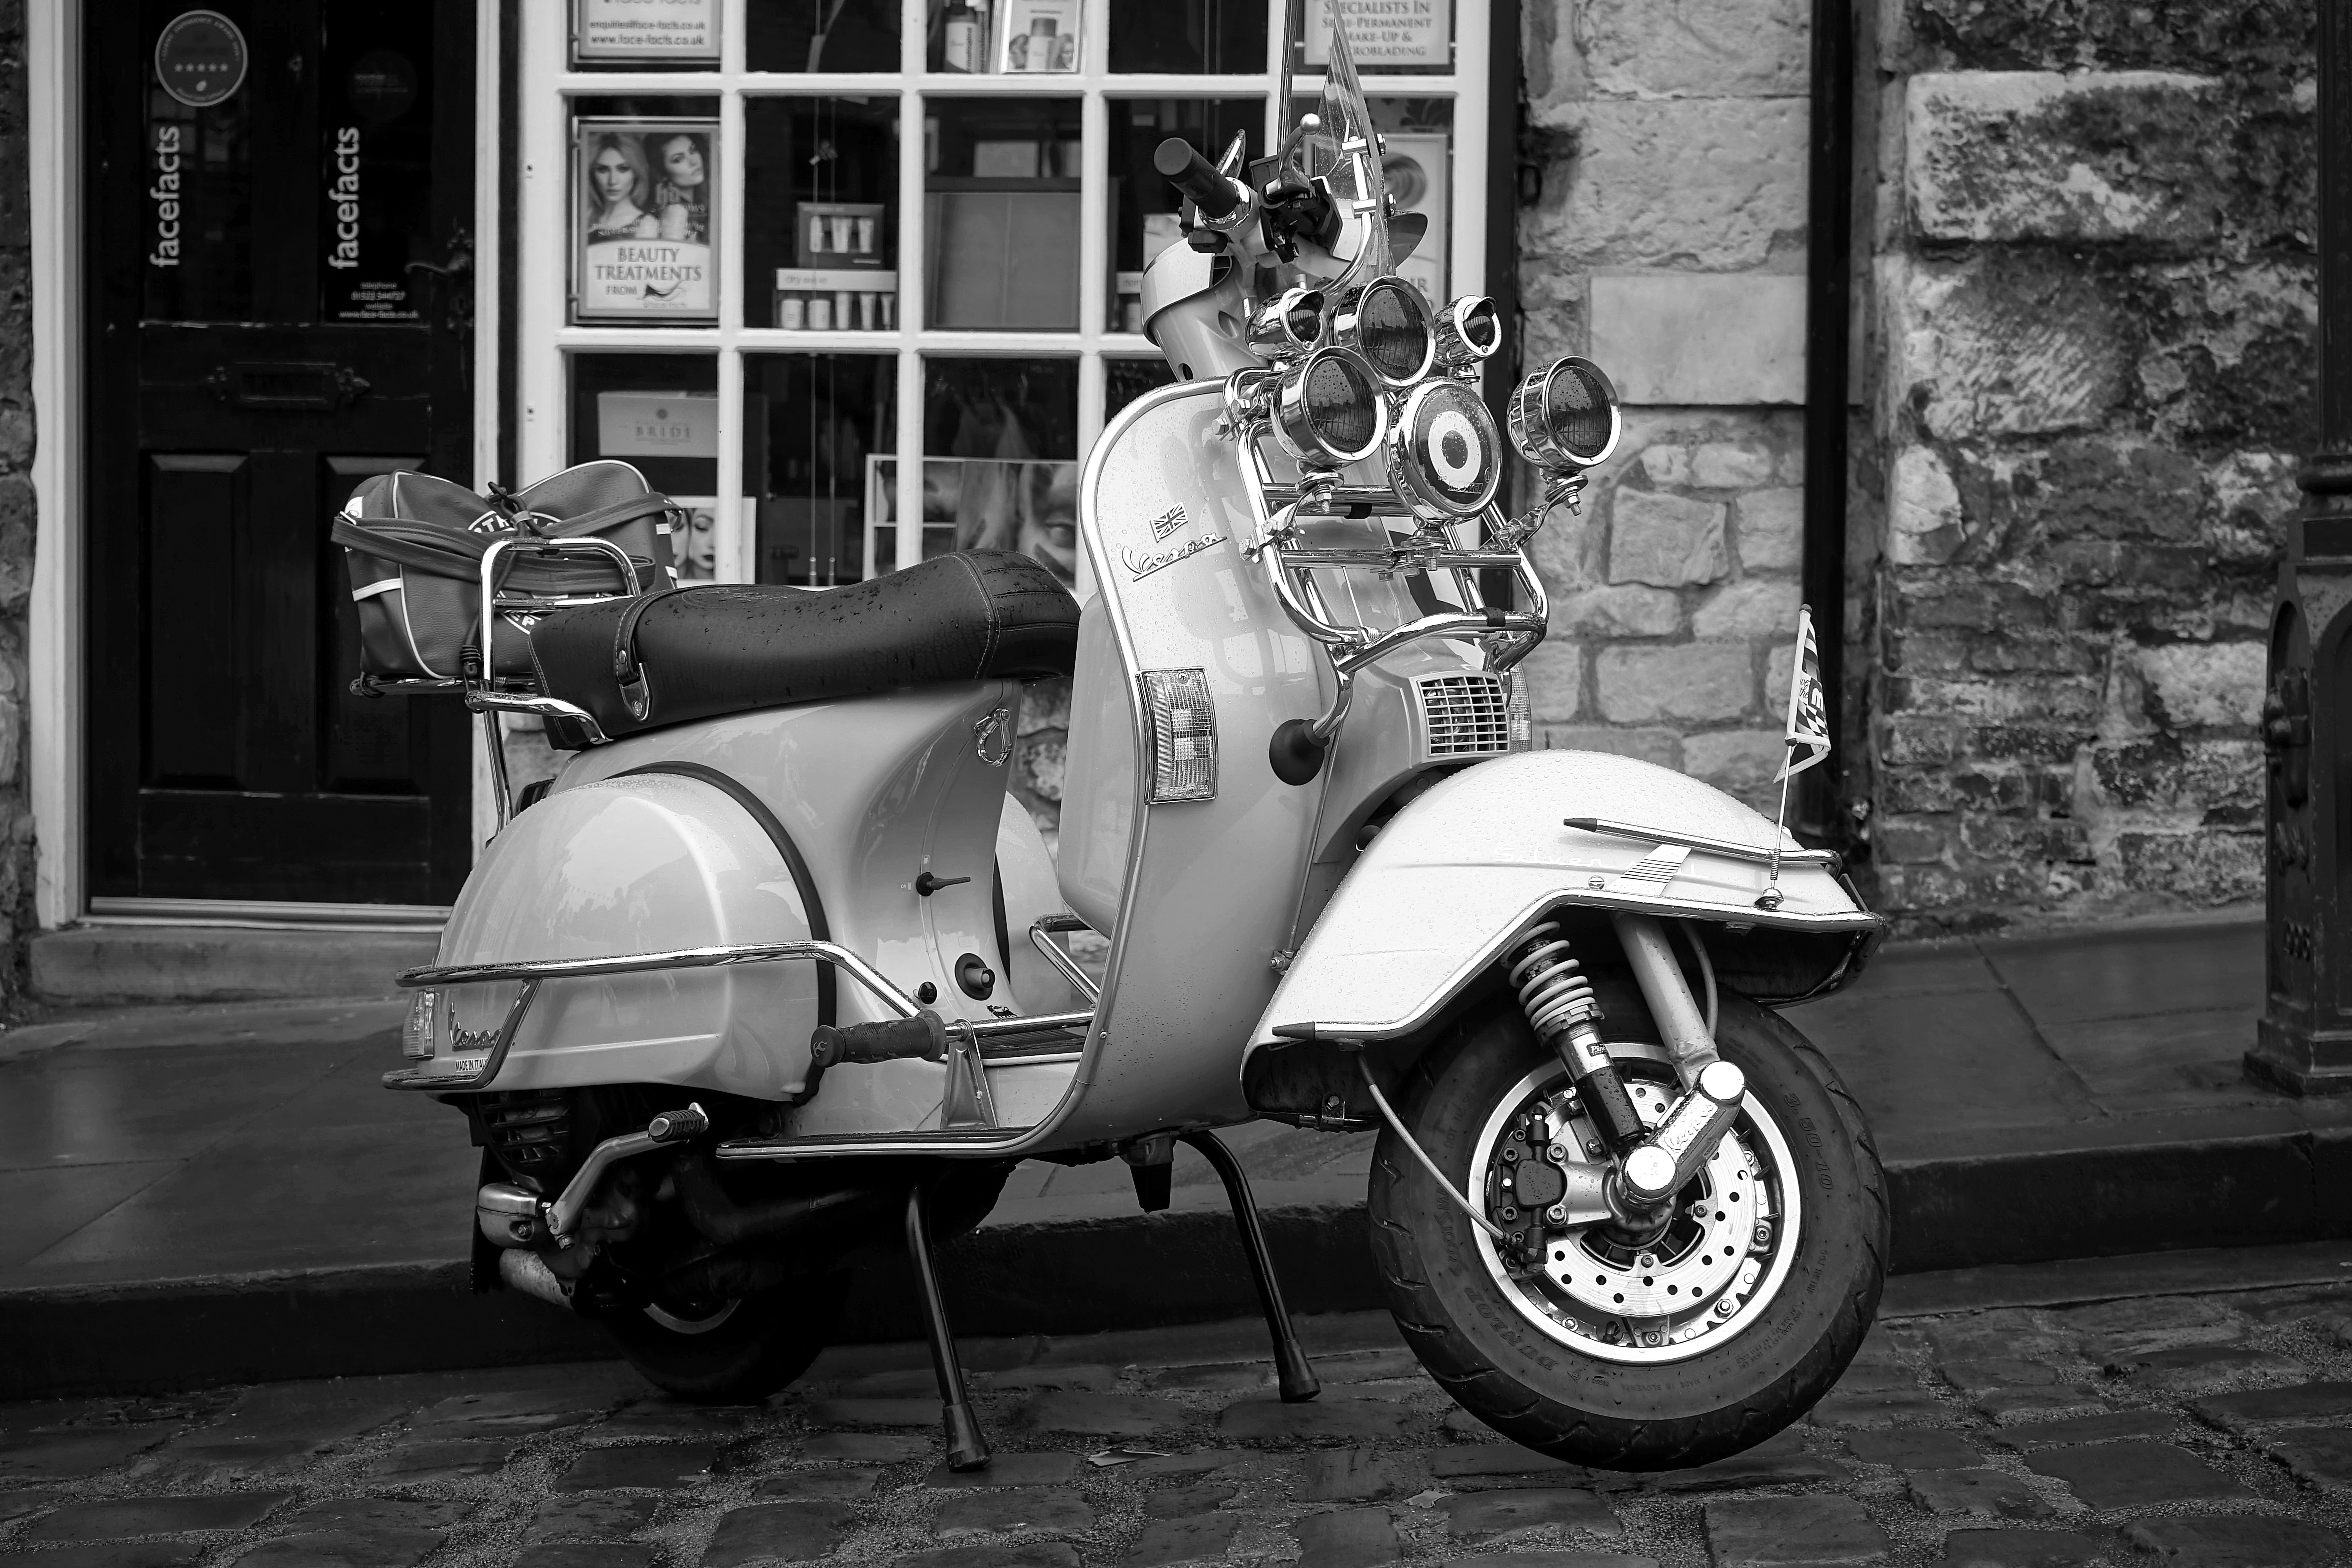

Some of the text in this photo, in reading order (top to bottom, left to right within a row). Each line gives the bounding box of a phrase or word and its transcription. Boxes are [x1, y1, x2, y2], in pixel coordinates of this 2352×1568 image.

[1323, 0, 1431, 14] SECIALISTS IN
[591, 34, 705, 45] www.face-facts.co.uk
[1402, 31, 1412, 42] &
[150, 125, 180, 267] facefacts
[328, 127, 359, 269] facefacts
[617, 246, 680, 262] BEAUTY
[594, 265, 702, 281] TREATMENTS
[605, 285, 637, 296] FROM
[636, 426, 690, 438] BRIDE
[1122, 532, 1227, 582] Vespa
[1494, 847, 1615, 869] Silver
[456, 1060, 468, 1071] MADE
[468, 1060, 474, 1071] IN
[1784, 1092, 1833, 1189] 3.50-10
[1464, 1287, 1559, 1370] DUNLOP
[1621, 1377, 1700, 1392] MADE IN SLOVENIA
